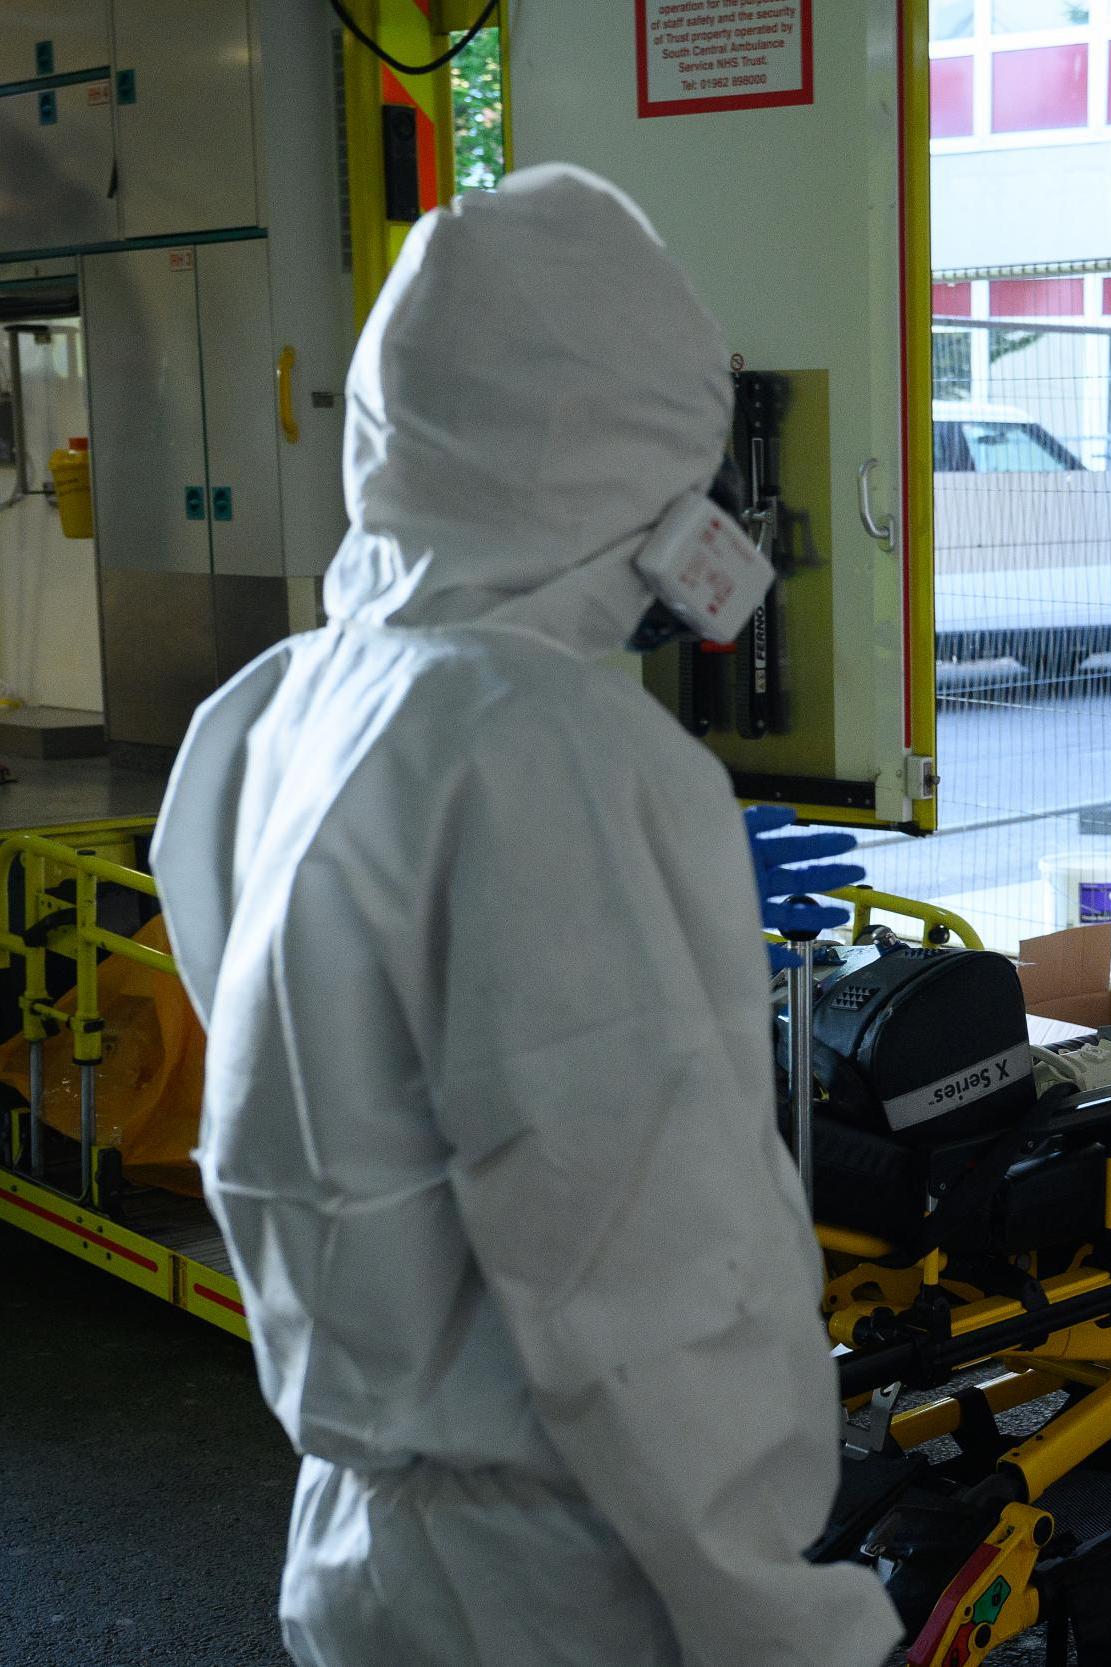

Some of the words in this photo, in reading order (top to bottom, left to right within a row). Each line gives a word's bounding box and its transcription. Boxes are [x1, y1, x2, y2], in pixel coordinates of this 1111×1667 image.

[651, 20, 660, 30] of
[664, 17, 684, 28] staff
[687, 15, 715, 27] safety
[718, 14, 734, 23] and
[738, 10, 752, 20] the
[756, 6, 796, 19] security
[659, 2, 704, 15] operation
[707, 0, 719, 8] for
[654, 35, 664, 45] of
[666, 32, 689, 43] Trust
[691, 29, 731, 42] property
[734, 24, 778, 37] operated
[781, 22, 793, 34] by
[662, 47, 690, 59] South
[693, 43, 726, 56] Central
[731, 39, 785, 52] Ambulance
[679, 60, 714, 73] Service
[717, 57, 738, 69] NHS
[755, 605, 766, 660] FERNO
[995, 1059, 1010, 1080] X
